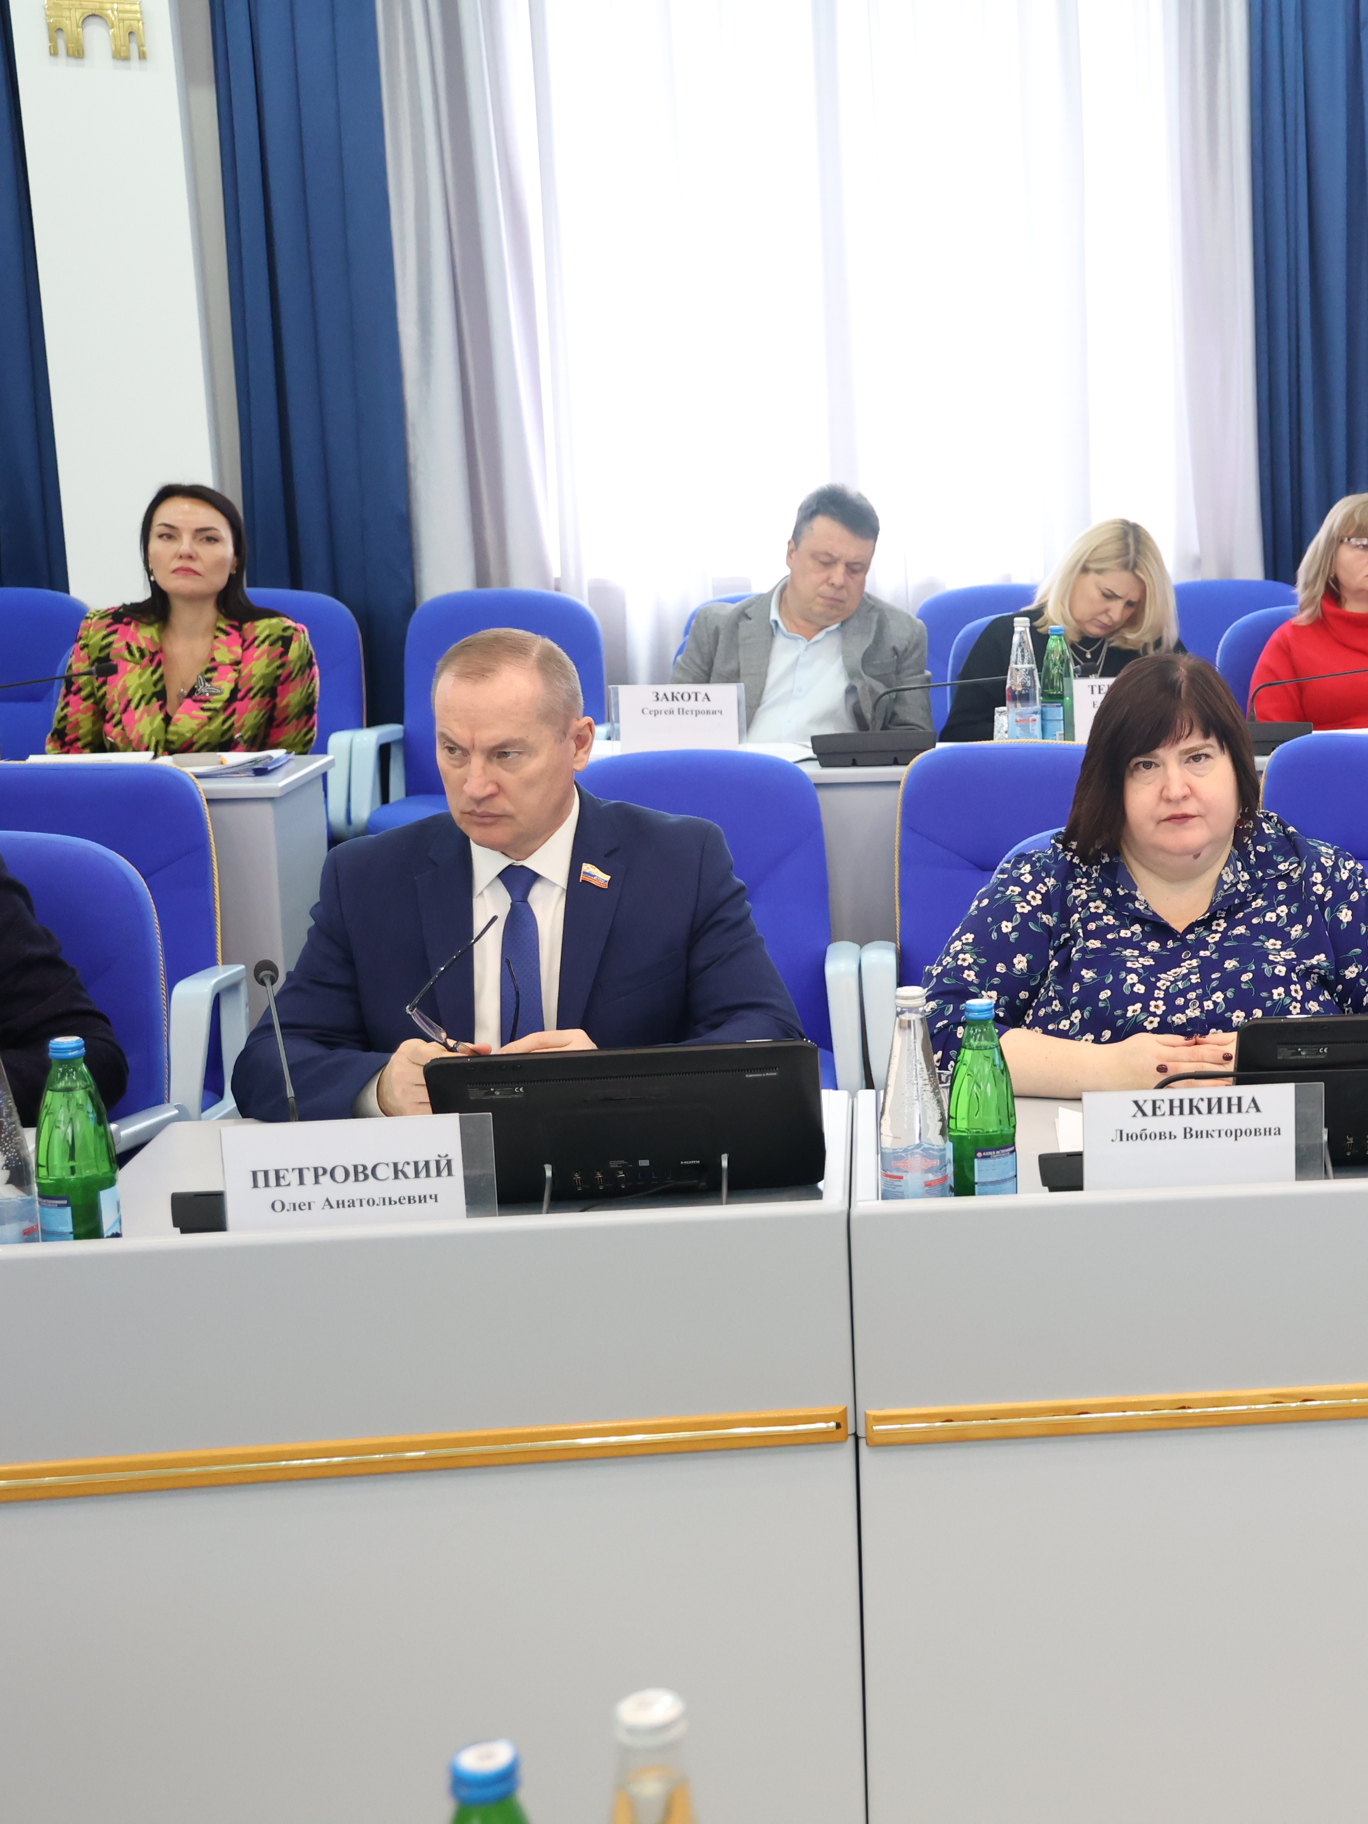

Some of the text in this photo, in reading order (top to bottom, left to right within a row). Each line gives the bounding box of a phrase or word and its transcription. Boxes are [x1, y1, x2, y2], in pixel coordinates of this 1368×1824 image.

[652, 691, 711, 702] ЗАКОТА
[1088, 684, 1110, 695] ТЕ
[641, 707, 723, 718] Сергей Петрович
[1131, 1095, 1262, 1118] ХЕНКИНА
[1111, 1126, 1282, 1143] Любовь Викторовна
[250, 1153, 455, 1189] ПЕТРОВСКИЙ
[270, 1193, 439, 1213] Олег Анатольевич
